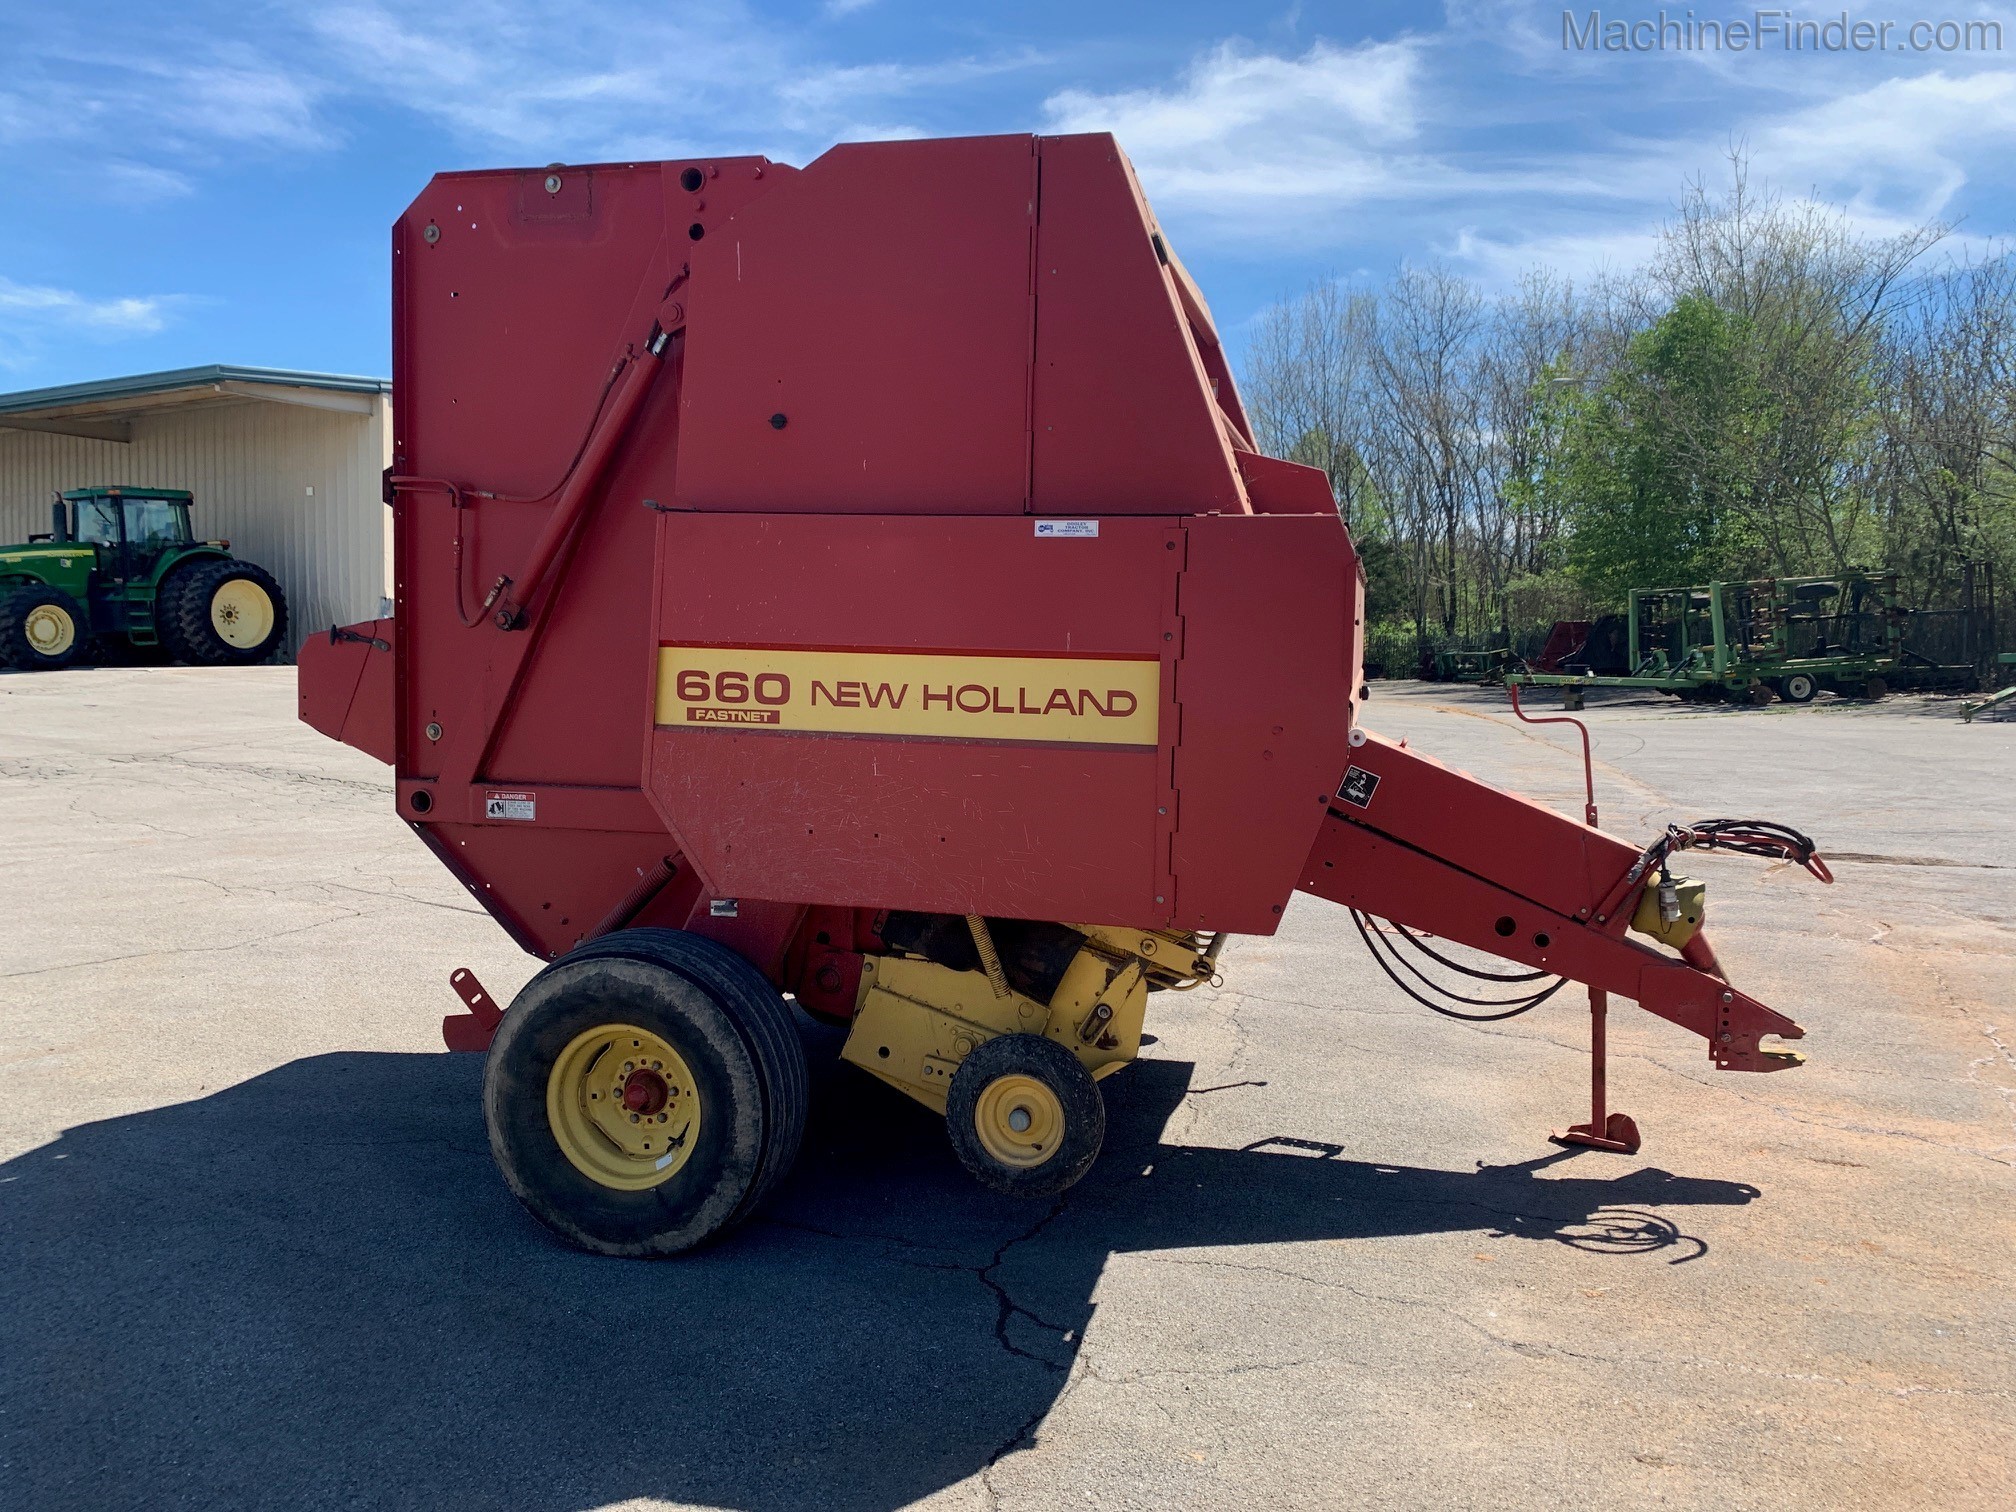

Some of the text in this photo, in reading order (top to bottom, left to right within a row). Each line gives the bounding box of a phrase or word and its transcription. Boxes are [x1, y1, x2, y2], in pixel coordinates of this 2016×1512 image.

[676, 669, 1138, 718] 660 NEW HOLLAND
[694, 708, 772, 723] FASTNET
[501, 793, 527, 801] DANGER
